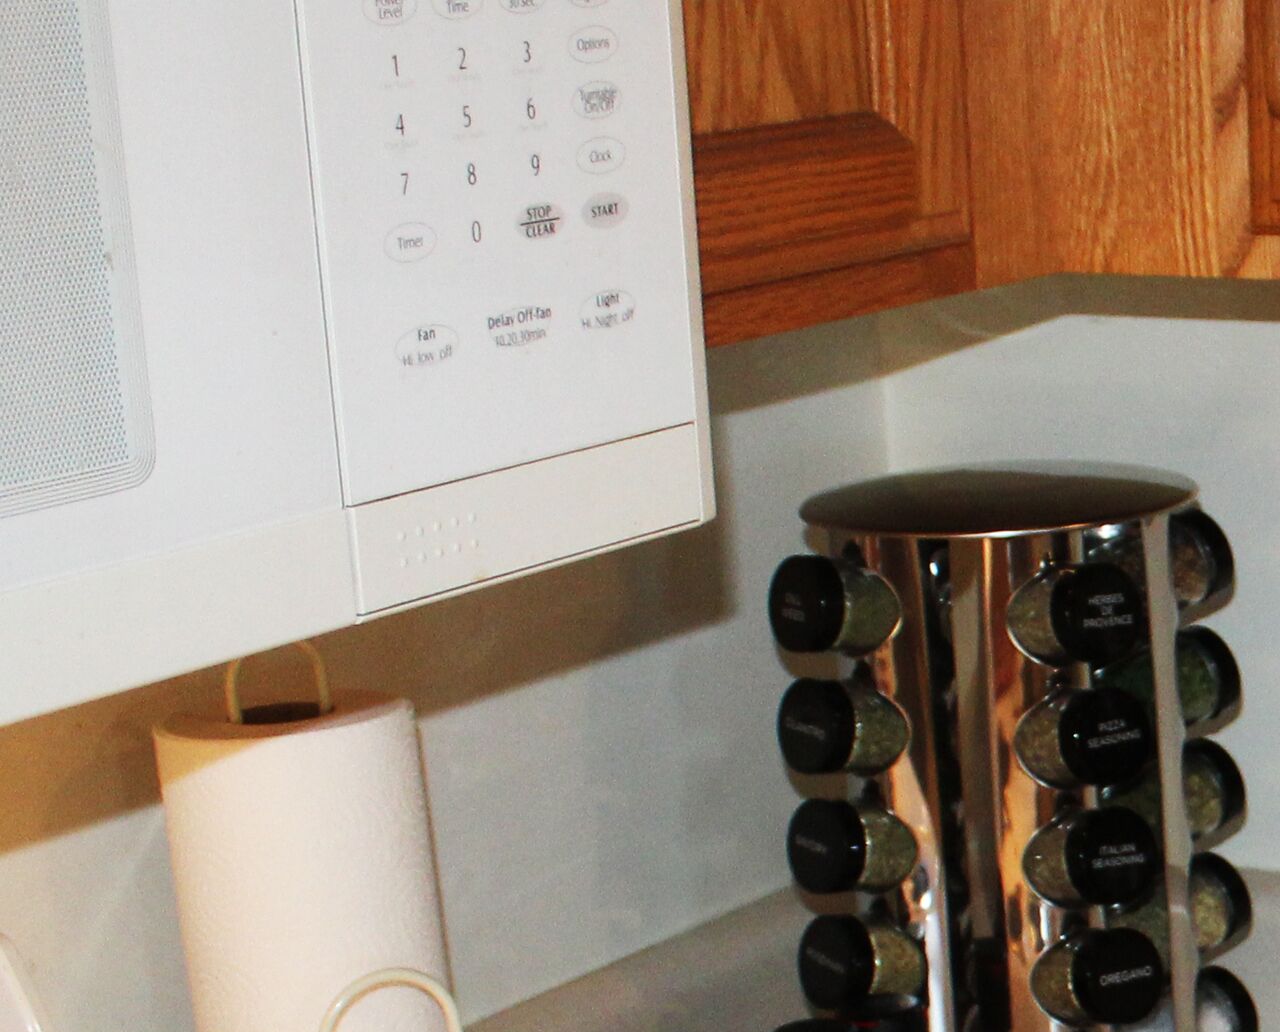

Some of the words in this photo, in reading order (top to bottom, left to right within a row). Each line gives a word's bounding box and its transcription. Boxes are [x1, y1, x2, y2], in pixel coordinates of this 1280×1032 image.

[523, 41, 531, 62] 3
[577, 38, 609, 52] Options
[392, 55, 399, 76] 1
[458, 48, 467, 70] 2
[463, 106, 471, 127] 5
[527, 98, 535, 119] 6
[396, 114, 404, 135] 4
[467, 163, 476, 185] 8
[531, 154, 540, 176] 9
[401, 174, 408, 195] 7
[526, 205, 553, 220] STOP
[591, 203, 619, 218] START
[472, 221, 481, 243] 0
[526, 223, 556, 238] CLEAR
[397, 235, 425, 251] Timer
[487, 313, 515, 331] Delay
[417, 328, 437, 342] Fan
[1088, 730, 1142, 749] SEASONING
[1092, 853, 1144, 869] SEASONING
[1101, 966, 1152, 986] OREGANO
